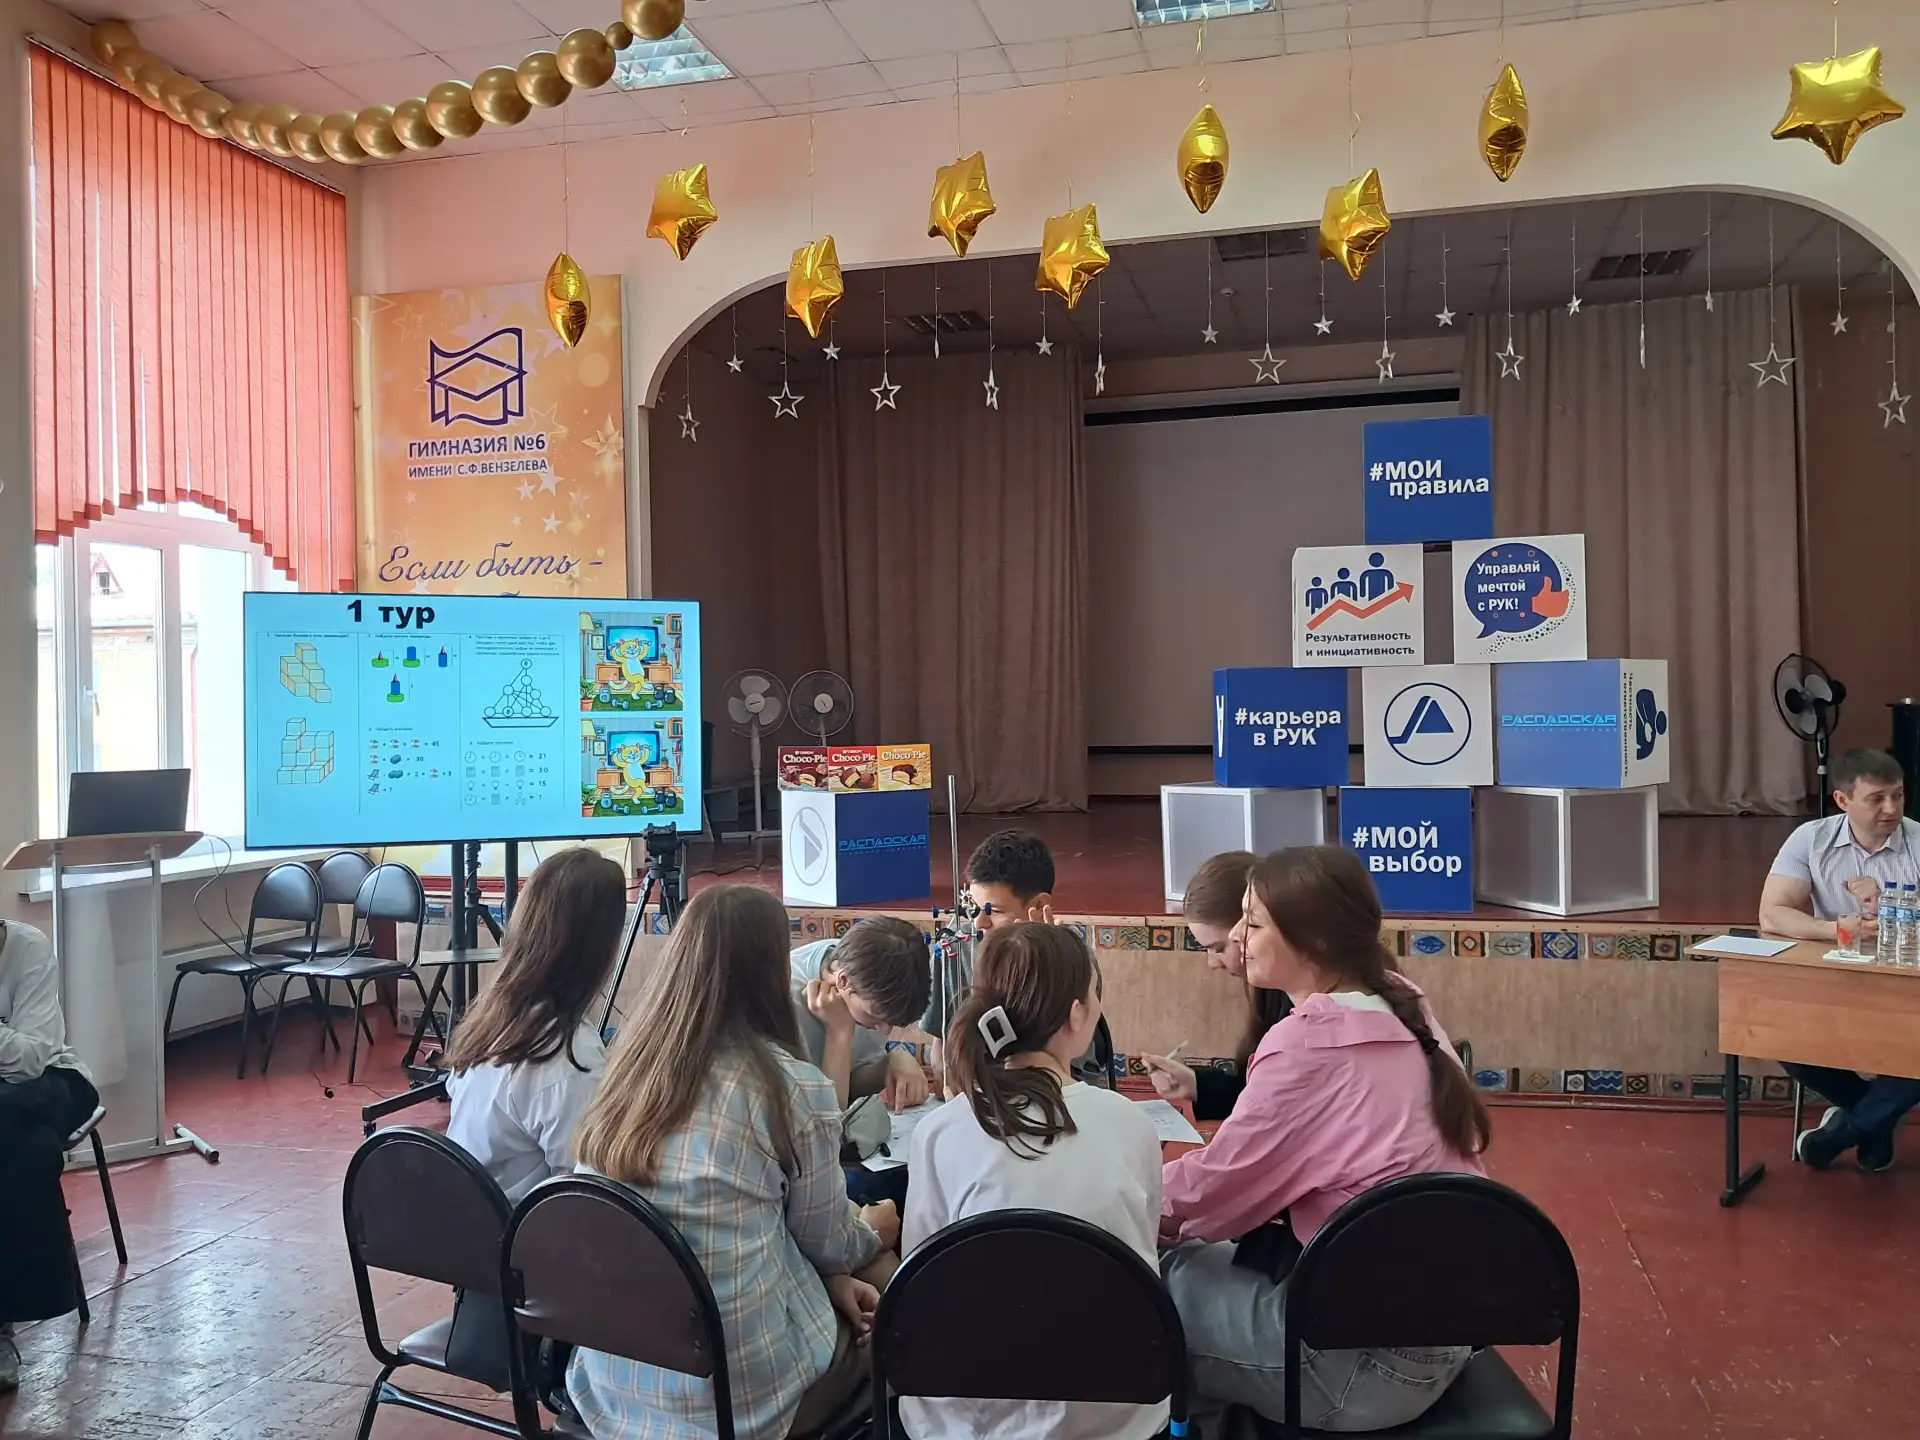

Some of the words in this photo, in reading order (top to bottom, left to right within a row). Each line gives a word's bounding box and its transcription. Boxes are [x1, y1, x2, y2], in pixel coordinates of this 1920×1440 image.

[409, 436, 507, 458] ГИМНАЗИЯ
[514, 433, 546, 451] №6
[409, 465, 452, 478] ИМЕНИ
[457, 459, 548, 475] С.Ф.ВЕНЗЕЛЕВА
[1369, 459, 1443, 481] #МОИ
[1389, 477, 1489, 500] правила
[378, 545, 470, 582] Если
[475, 541, 580, 579] быть
[1476, 560, 1540, 577] Управляй
[1477, 579, 1526, 593] мечтой
[347, 599, 362, 623] 1
[377, 605, 436, 629] тур
[1477, 602, 1485, 611] с
[1488, 597, 1519, 611] РУК!
[1305, 632, 1412, 644] Результативность
[1305, 649, 1313, 657] и
[1316, 647, 1415, 657] инициативность
[1234, 707, 1341, 728] #карьера
[1253, 732, 1267, 746] в
[1273, 727, 1317, 746] РУК
[1352, 820, 1438, 849] #МОЙ
[1369, 849, 1462, 878] выбор
